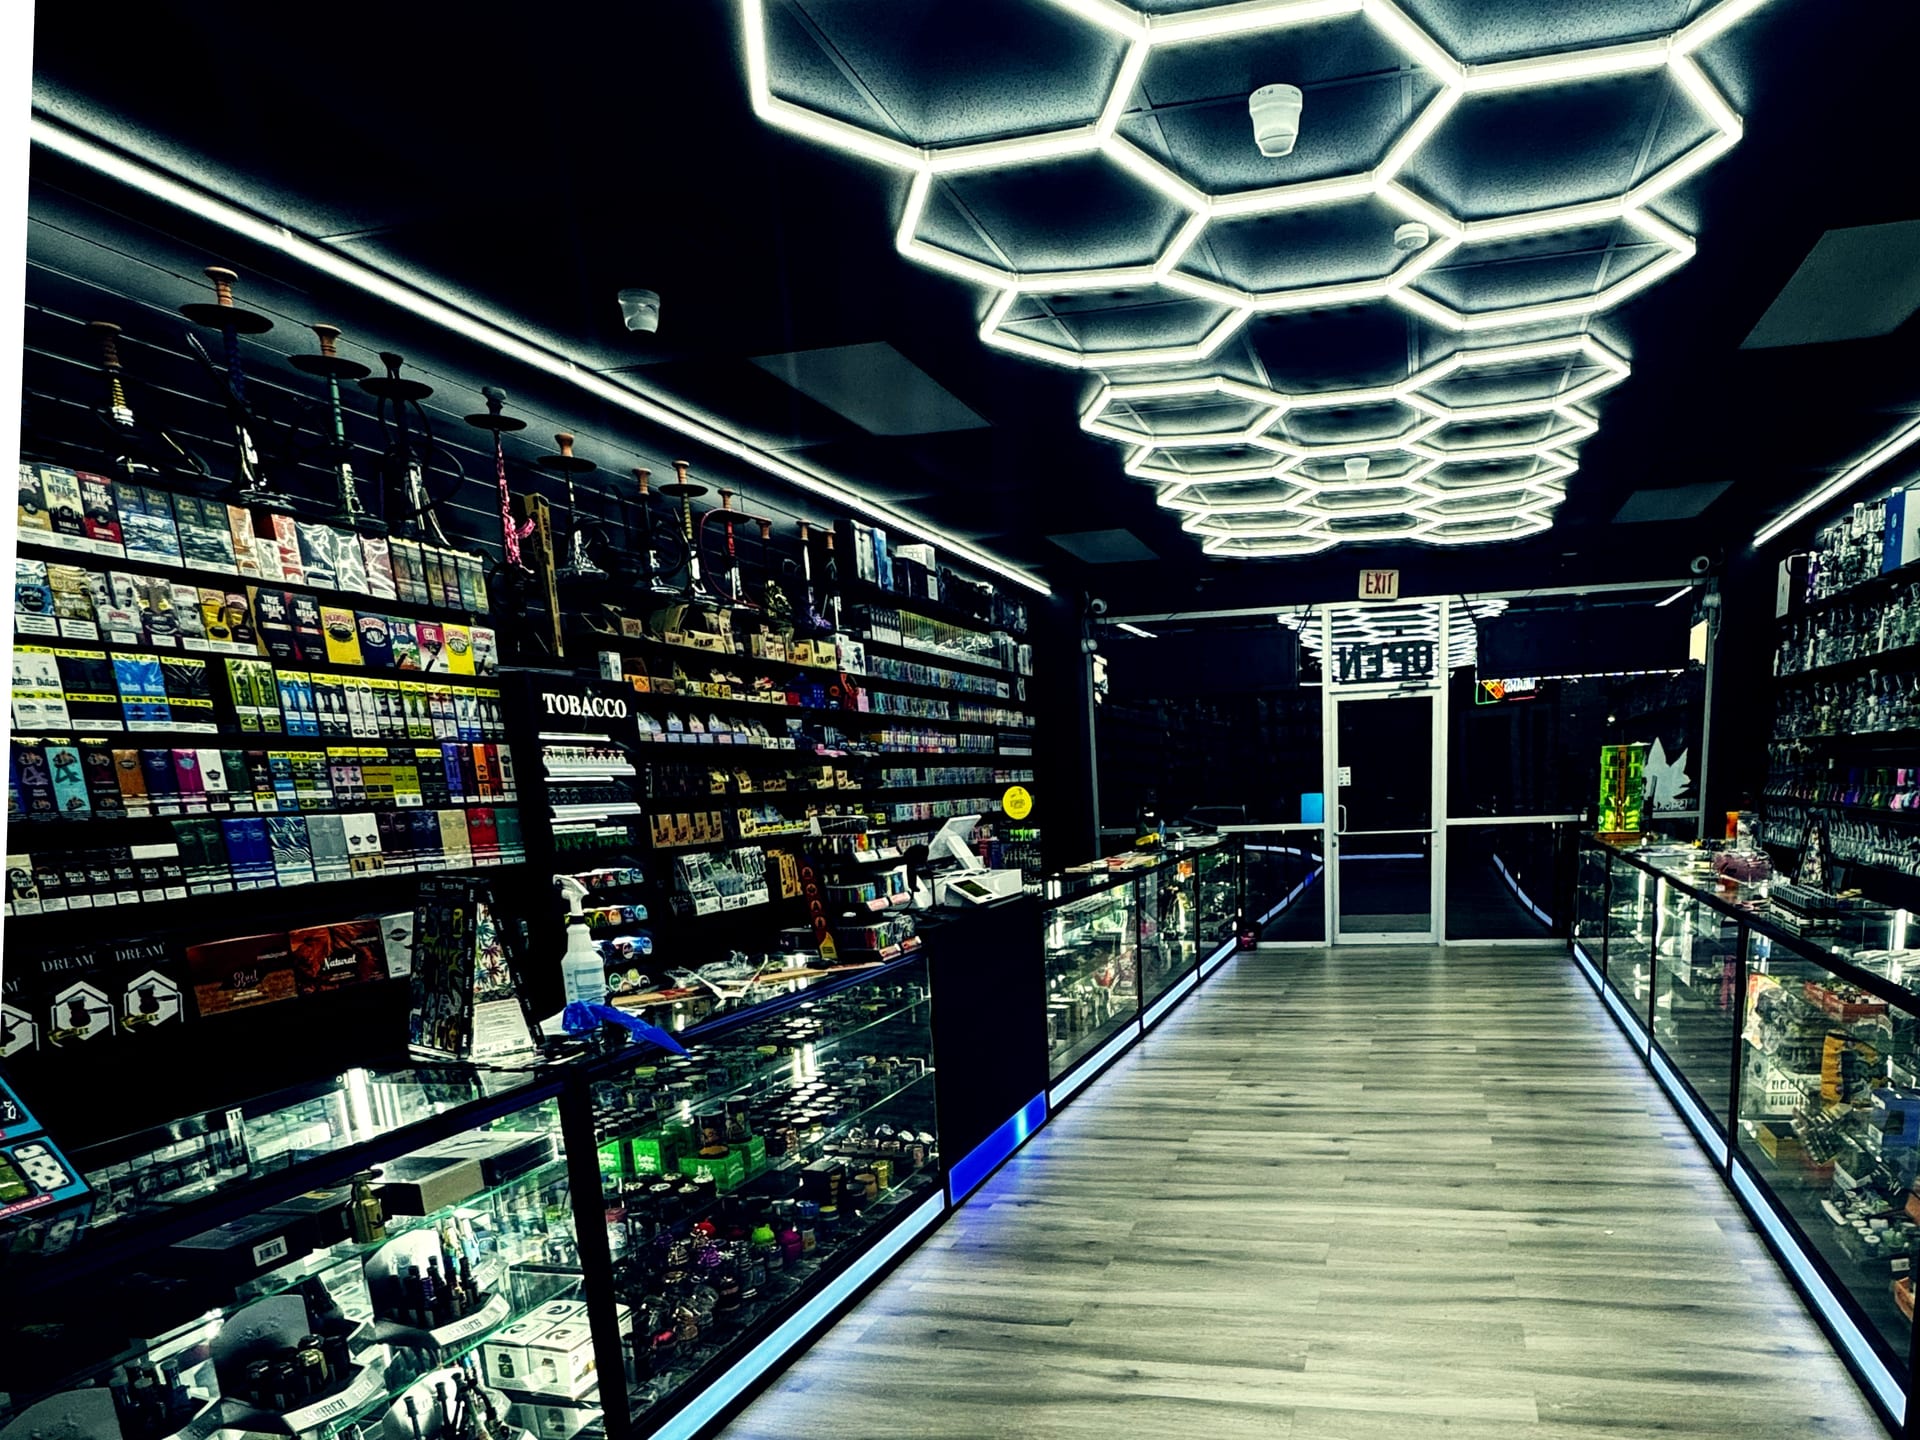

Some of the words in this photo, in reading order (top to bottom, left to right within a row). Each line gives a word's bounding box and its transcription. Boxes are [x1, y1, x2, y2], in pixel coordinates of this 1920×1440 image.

[1365, 572, 1394, 595] EXIT
[36, 677, 60, 687] Dutch
[542, 692, 627, 719] TOBACCO
[12, 875, 31, 883] Black
[65, 870, 84, 878] Black
[89, 870, 108, 878] Black
[115, 944, 164, 961] DREAM
[41, 954, 95, 972] DREAM
[322, 954, 358, 971] Natural
